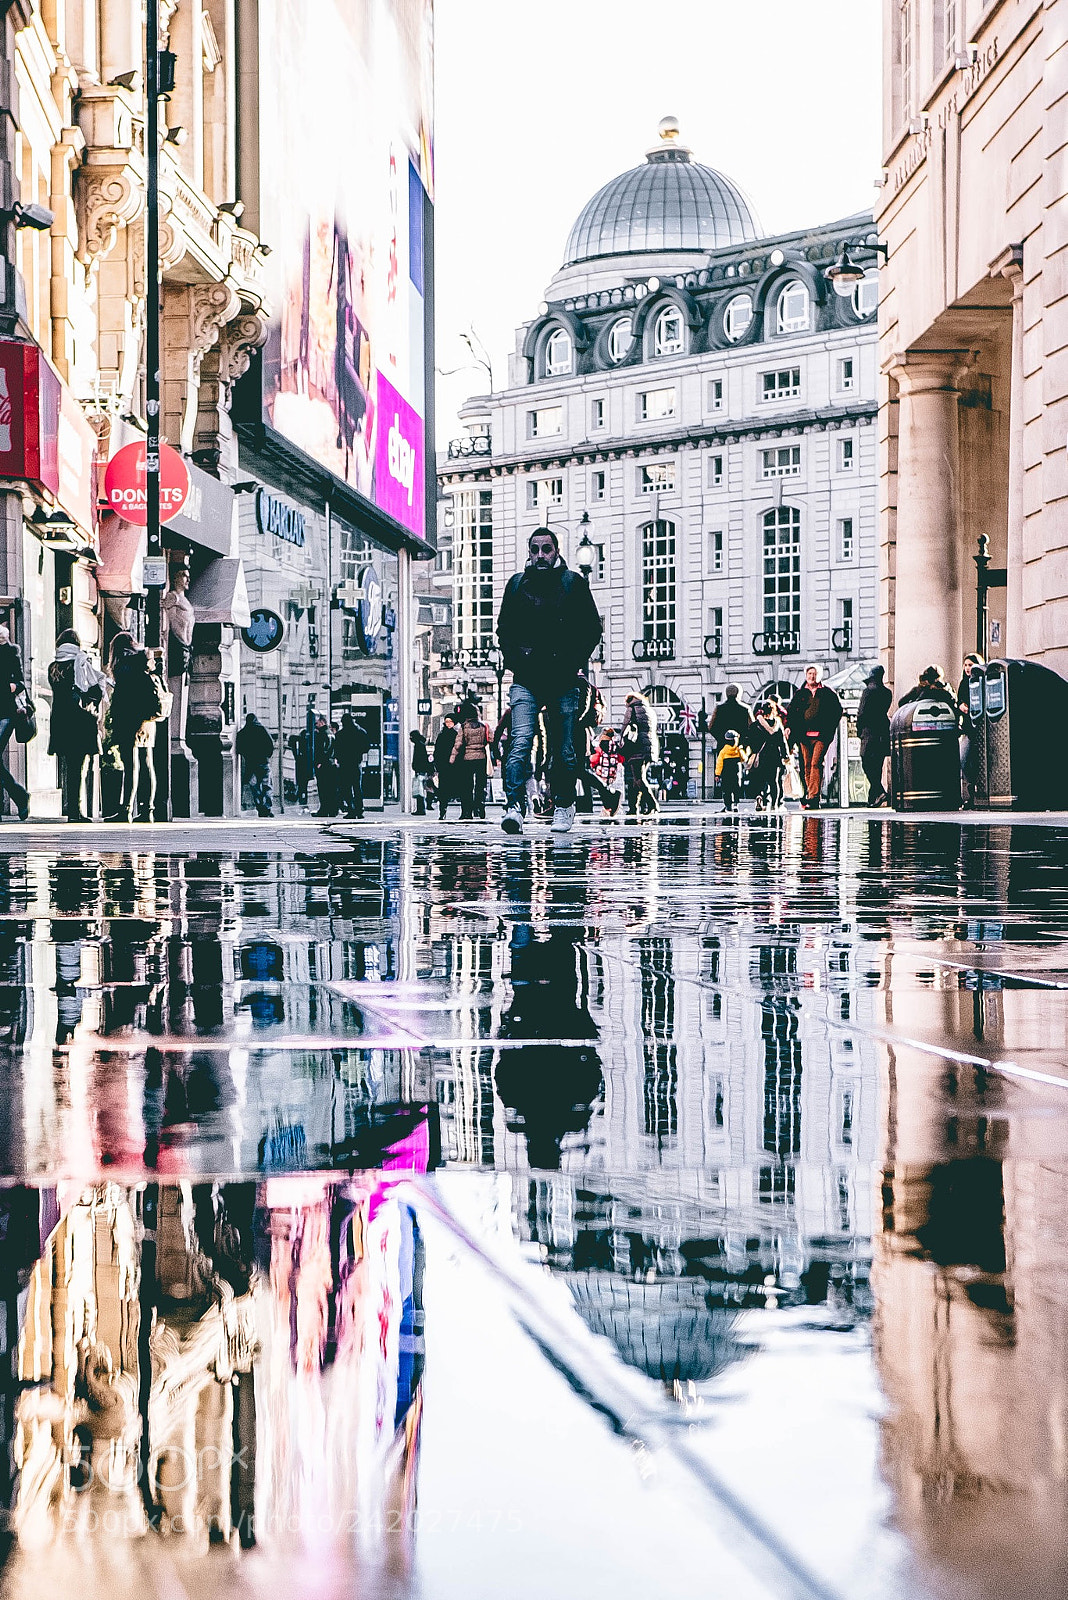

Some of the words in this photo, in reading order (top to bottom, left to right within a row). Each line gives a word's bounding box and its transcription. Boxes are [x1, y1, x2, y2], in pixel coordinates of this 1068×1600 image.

[938, 90, 959, 129] LIFE
[388, 412, 416, 507] ebay
[111, 487, 183, 503] DONTS
